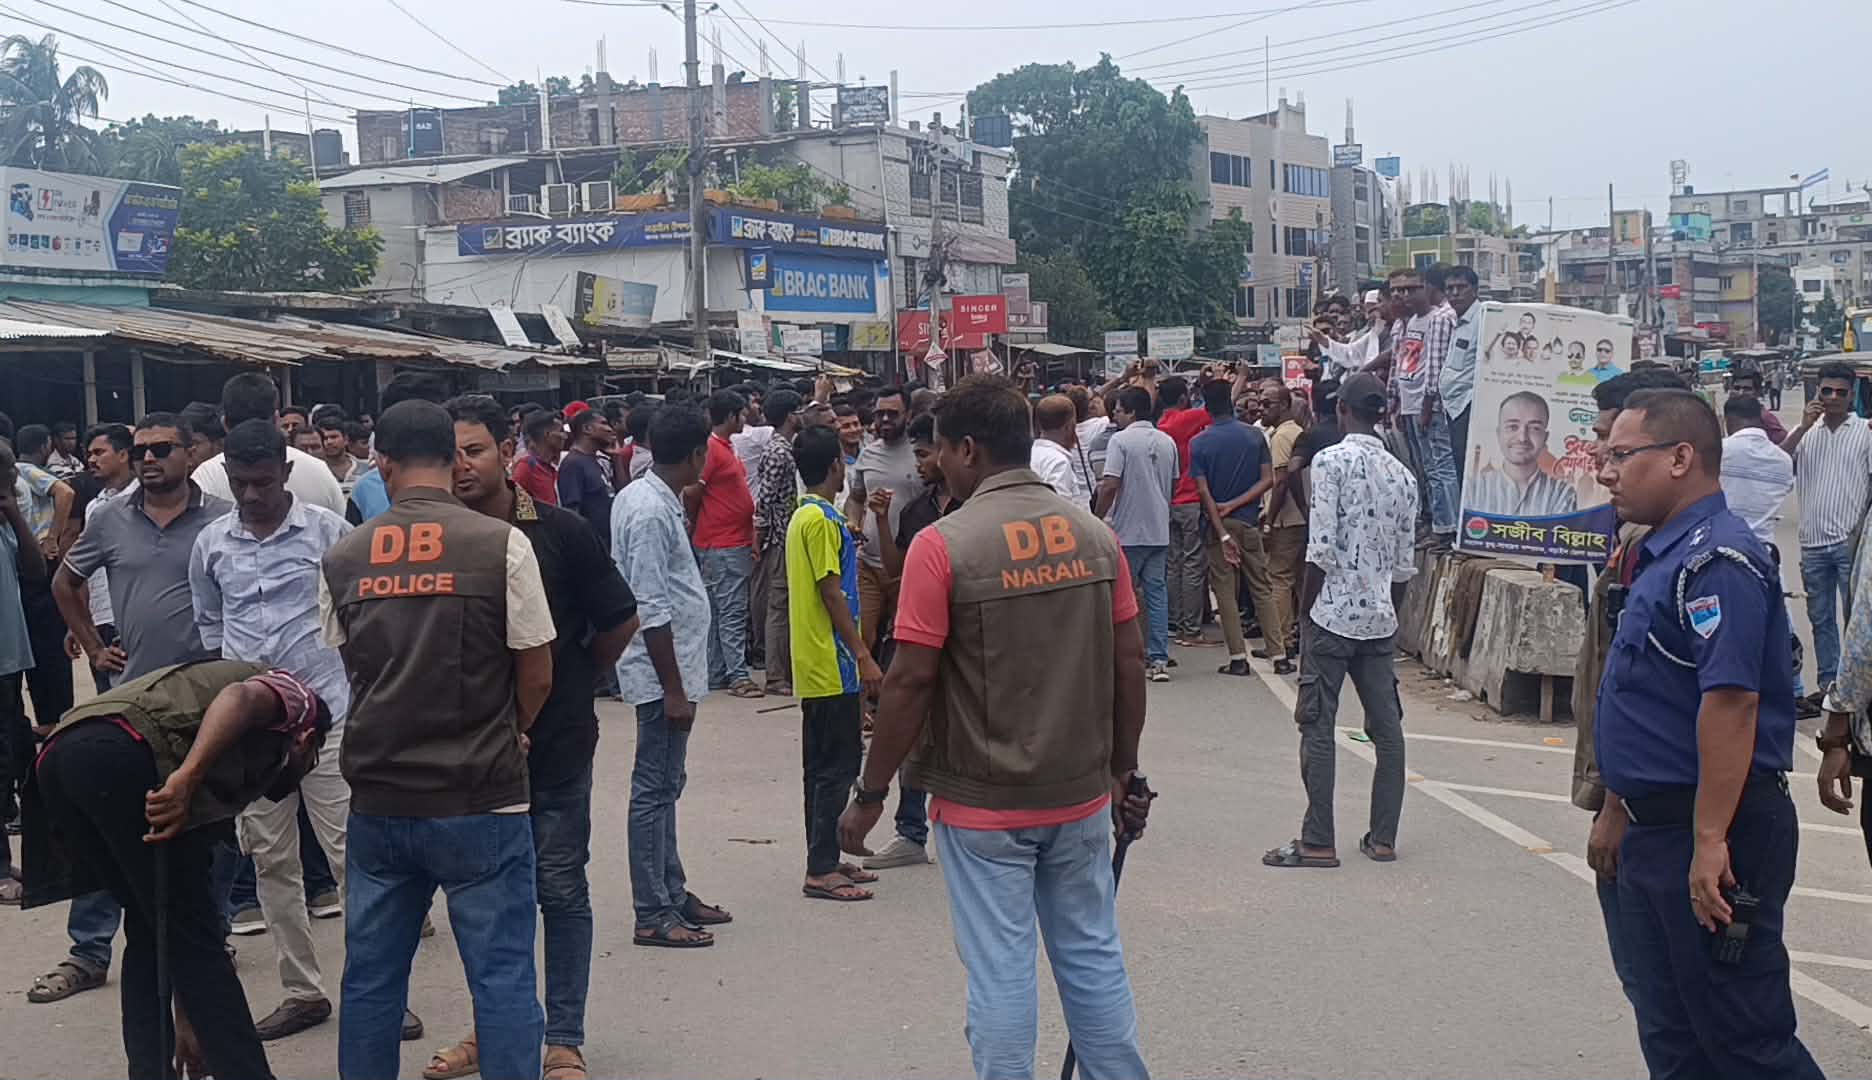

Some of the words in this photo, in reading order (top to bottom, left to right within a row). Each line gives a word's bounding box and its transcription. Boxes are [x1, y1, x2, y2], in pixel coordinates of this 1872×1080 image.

[505, 224, 552, 249] ব্র্যাক
[556, 221, 616, 245] ব্যাংক
[829, 228, 857, 248] BRAC
[857, 232, 886, 251] BANK
[784, 270, 827, 297] BRAC
[829, 273, 870, 300] BANK
[960, 304, 998, 313] SINGER
[370, 522, 443, 565] DB
[1001, 514, 1077, 561] DB
[1491, 521, 1547, 544] সজীব
[1552, 524, 1608, 550] বিল্লাহ
[358, 573, 455, 597] POLICE
[1001, 559, 1094, 590] NARAIL
